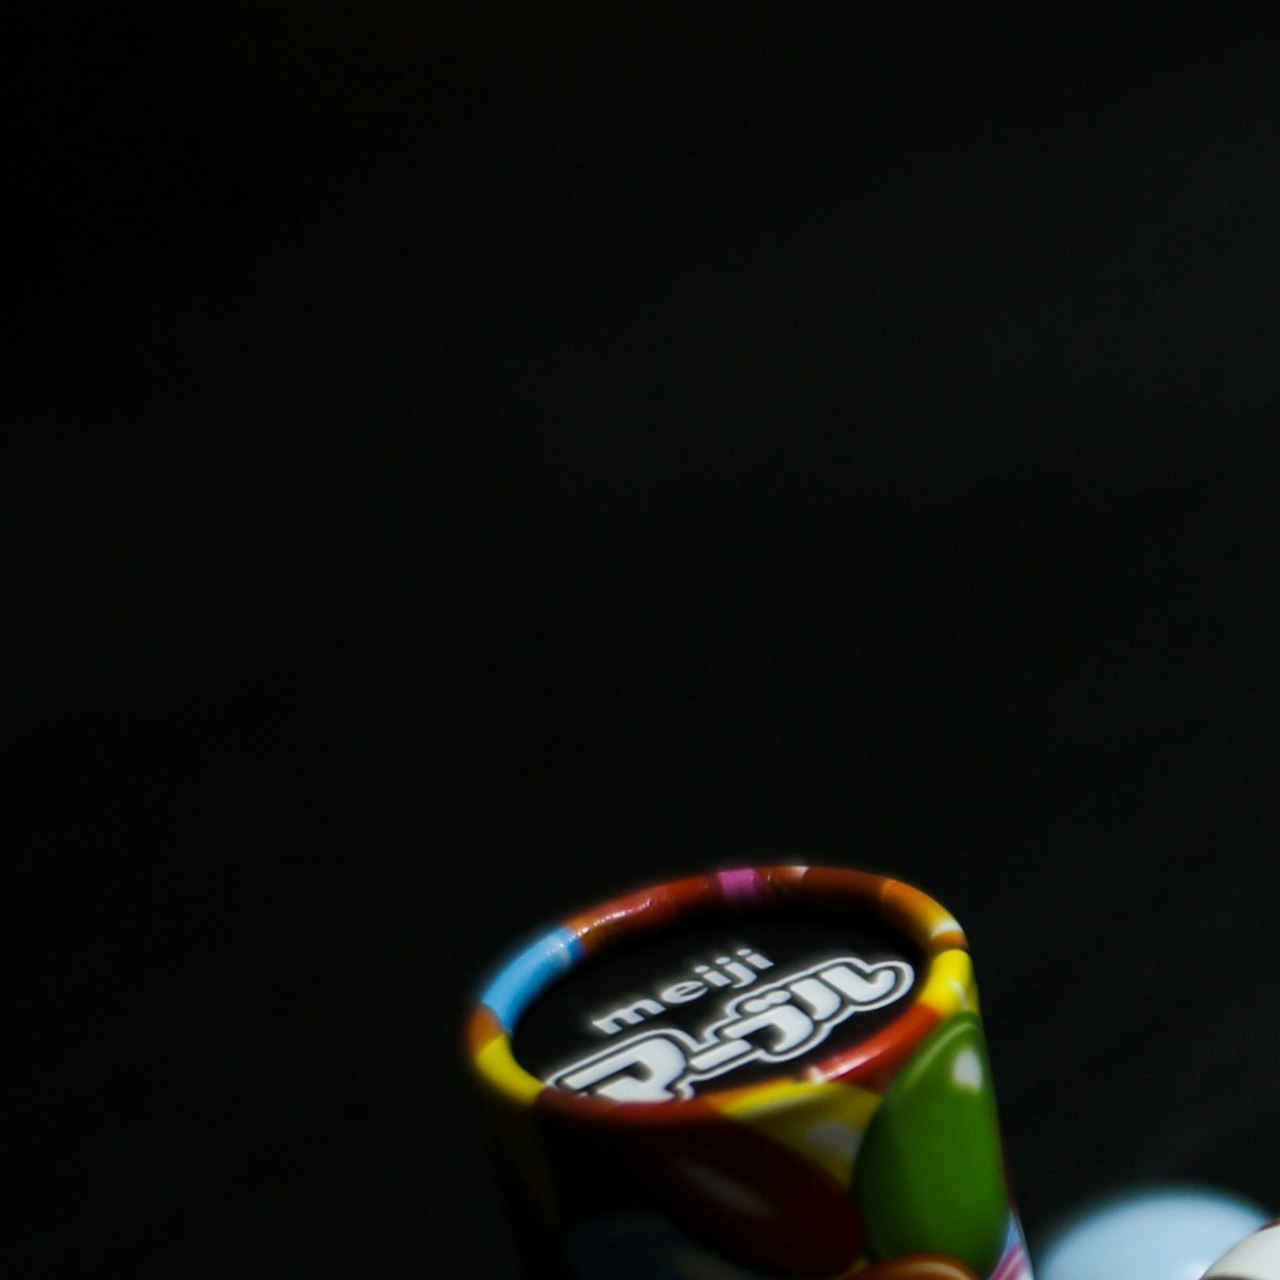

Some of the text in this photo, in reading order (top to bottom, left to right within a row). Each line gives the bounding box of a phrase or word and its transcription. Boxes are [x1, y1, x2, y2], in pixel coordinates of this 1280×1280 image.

[550, 958, 912, 1102] マーブル
[591, 949, 774, 1035] meiji
